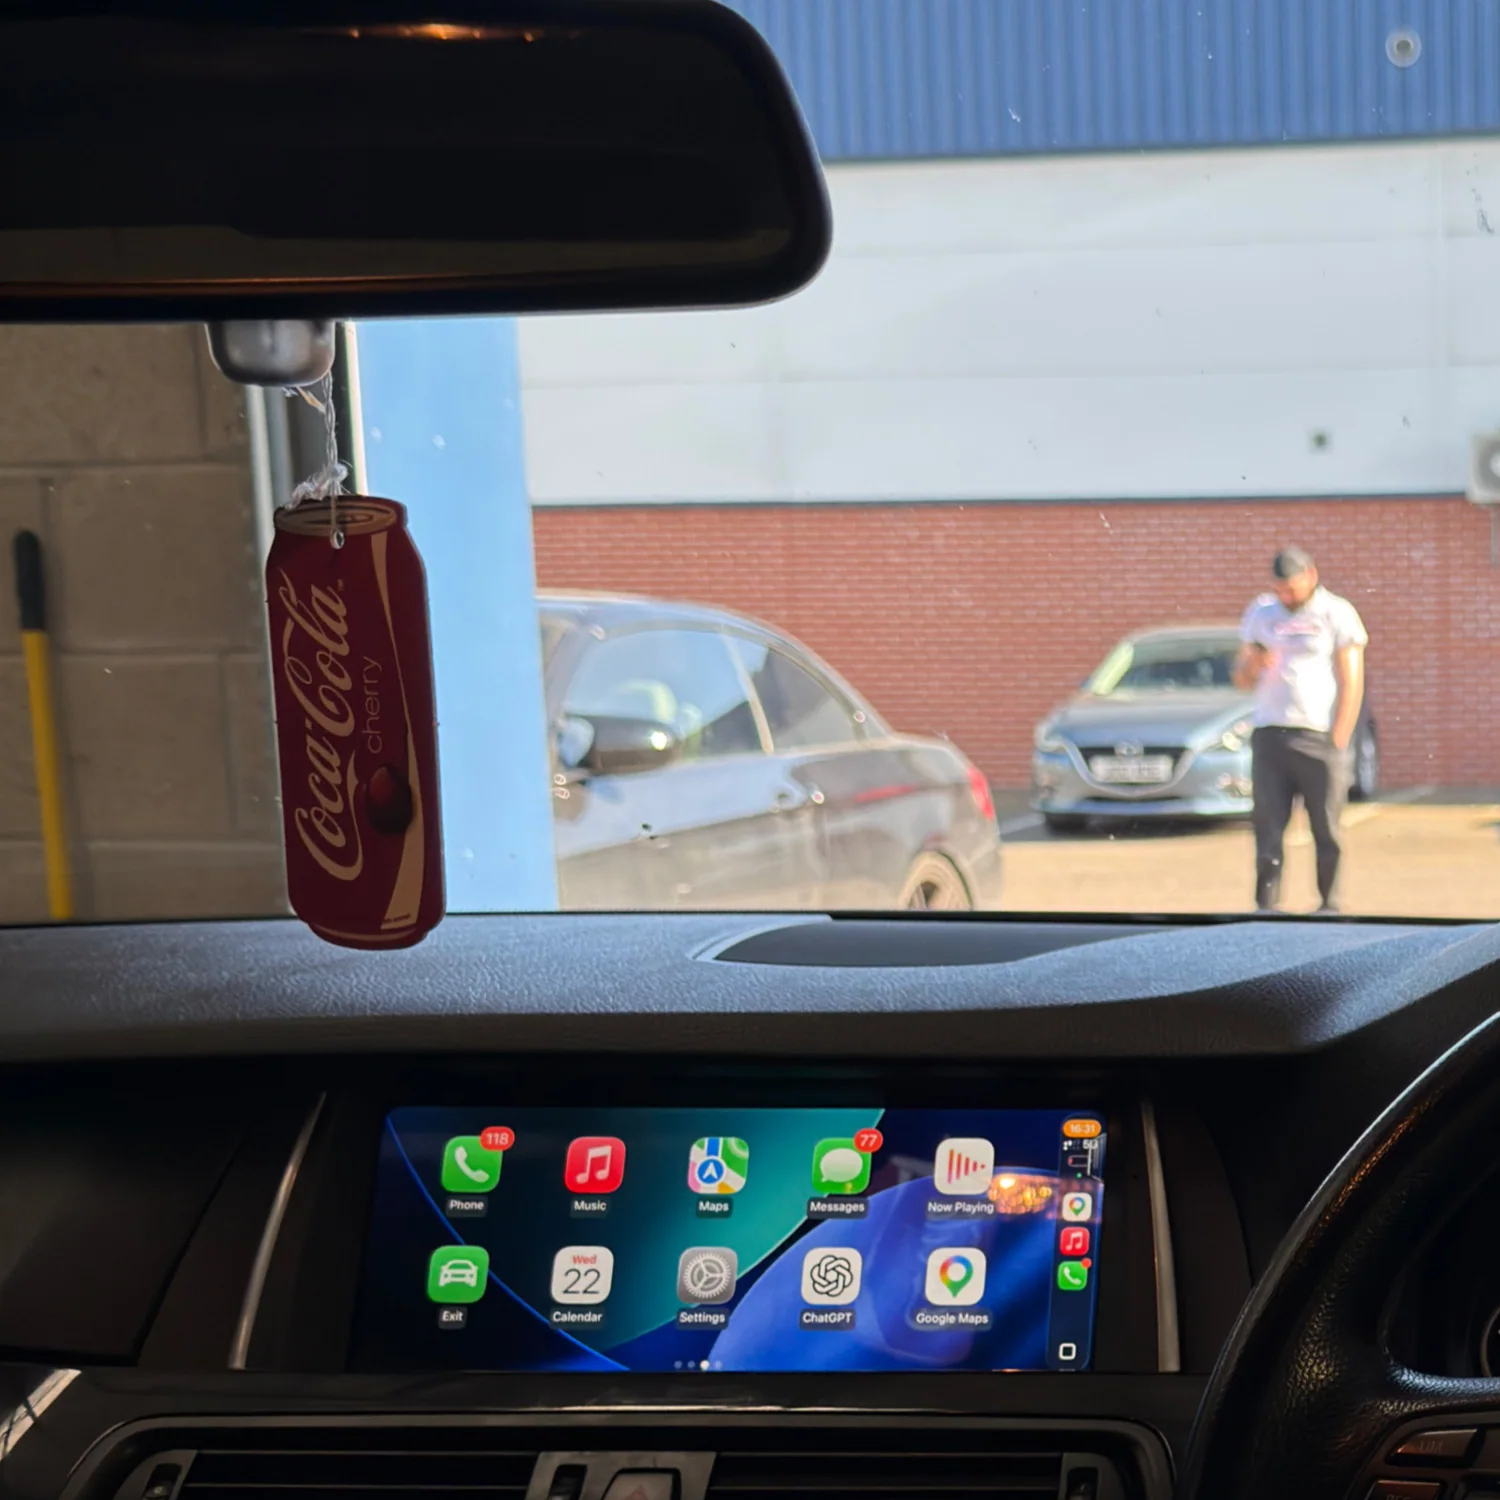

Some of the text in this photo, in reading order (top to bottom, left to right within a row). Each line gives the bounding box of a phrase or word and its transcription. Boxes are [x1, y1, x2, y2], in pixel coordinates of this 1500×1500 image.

[362, 655, 382, 754] cherry
[486, 1132, 508, 1145] 118
[860, 1134, 877, 1147] 77
[449, 1200, 484, 1211] Phone
[574, 1200, 607, 1211] Music
[699, 1201, 729, 1213] Maps
[810, 1201, 865, 1214] Messages
[927, 1202, 994, 1214] Now Playing
[572, 1254, 597, 1265] Wed
[562, 1268, 600, 1295] 22
[442, 1310, 463, 1322] Exit
[552, 1310, 602, 1322] Calendar
[679, 1311, 725, 1325] Settings
[802, 1311, 852, 1324] ChatGPT
[916, 1313, 989, 1326] Google Maps
